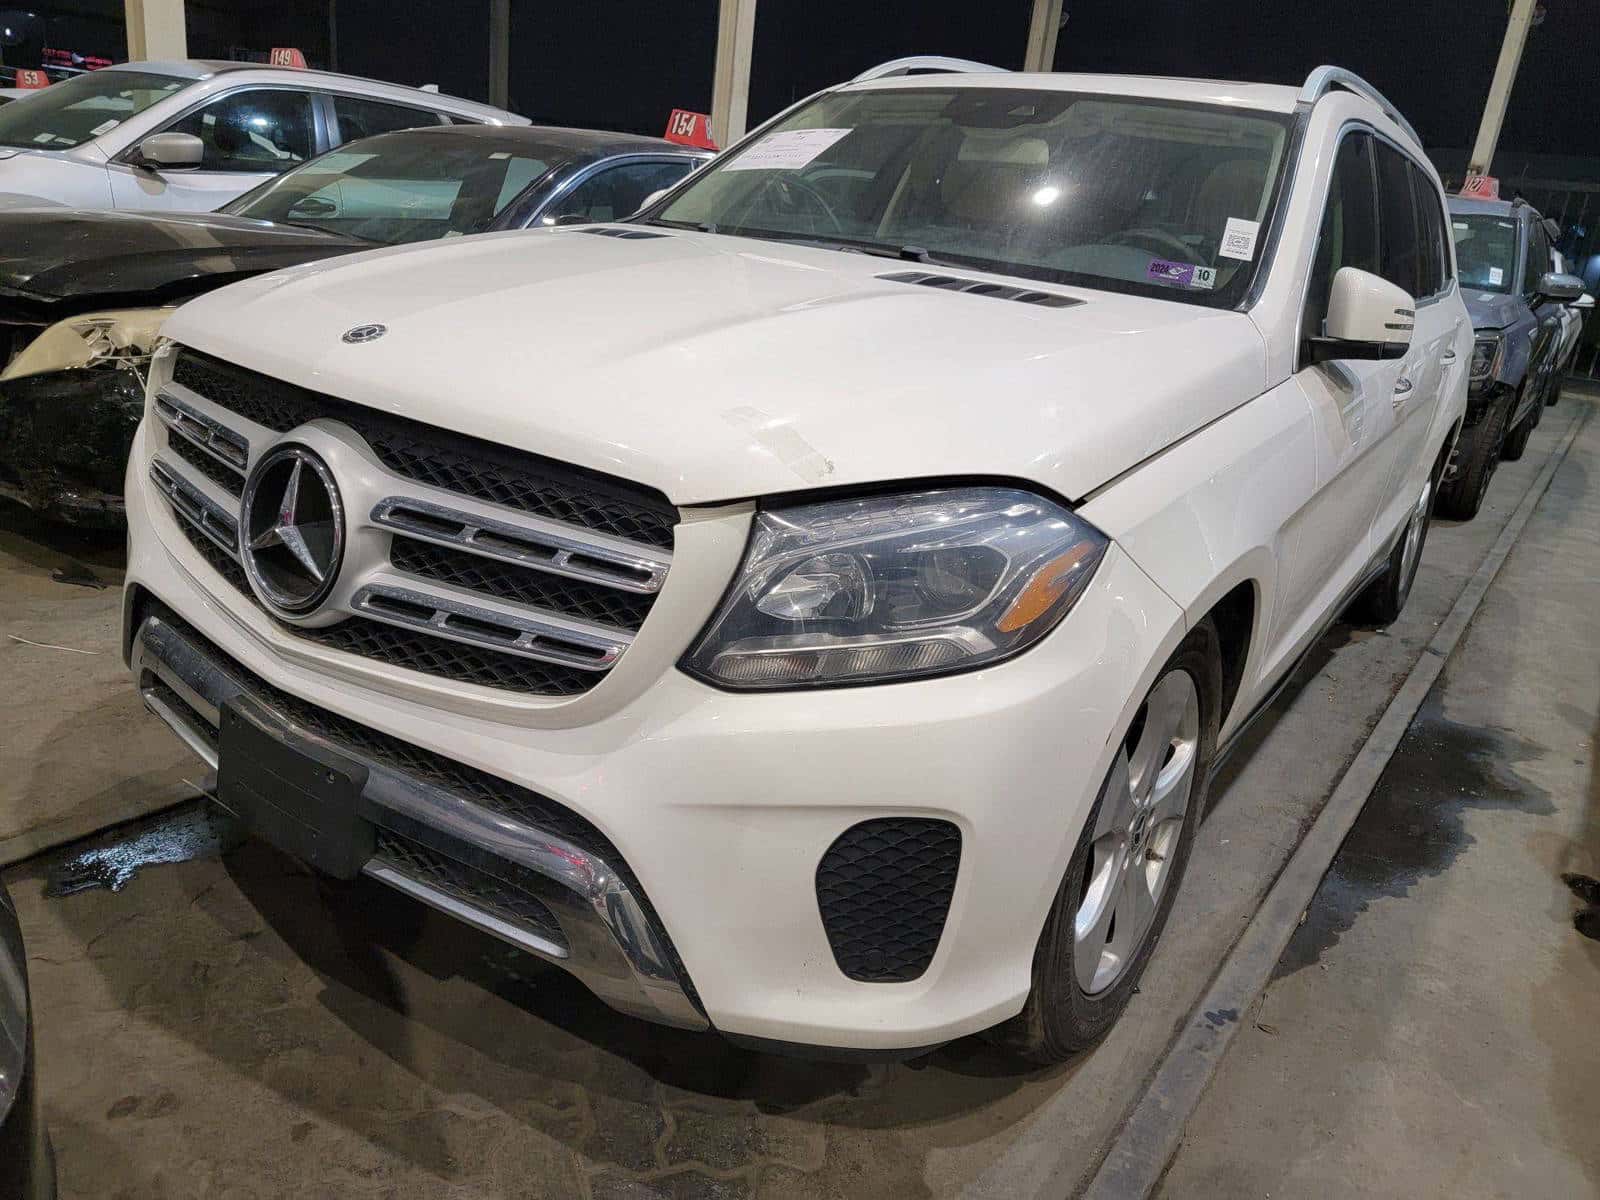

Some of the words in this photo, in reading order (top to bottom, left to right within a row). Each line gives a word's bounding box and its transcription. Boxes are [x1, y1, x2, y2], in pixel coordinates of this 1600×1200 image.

[274, 50, 291, 65] 149
[23, 71, 40, 85] 53
[671, 112, 697, 137] 154
[1150, 262, 1170, 273] 2024
[1198, 269, 1210, 281] 10
